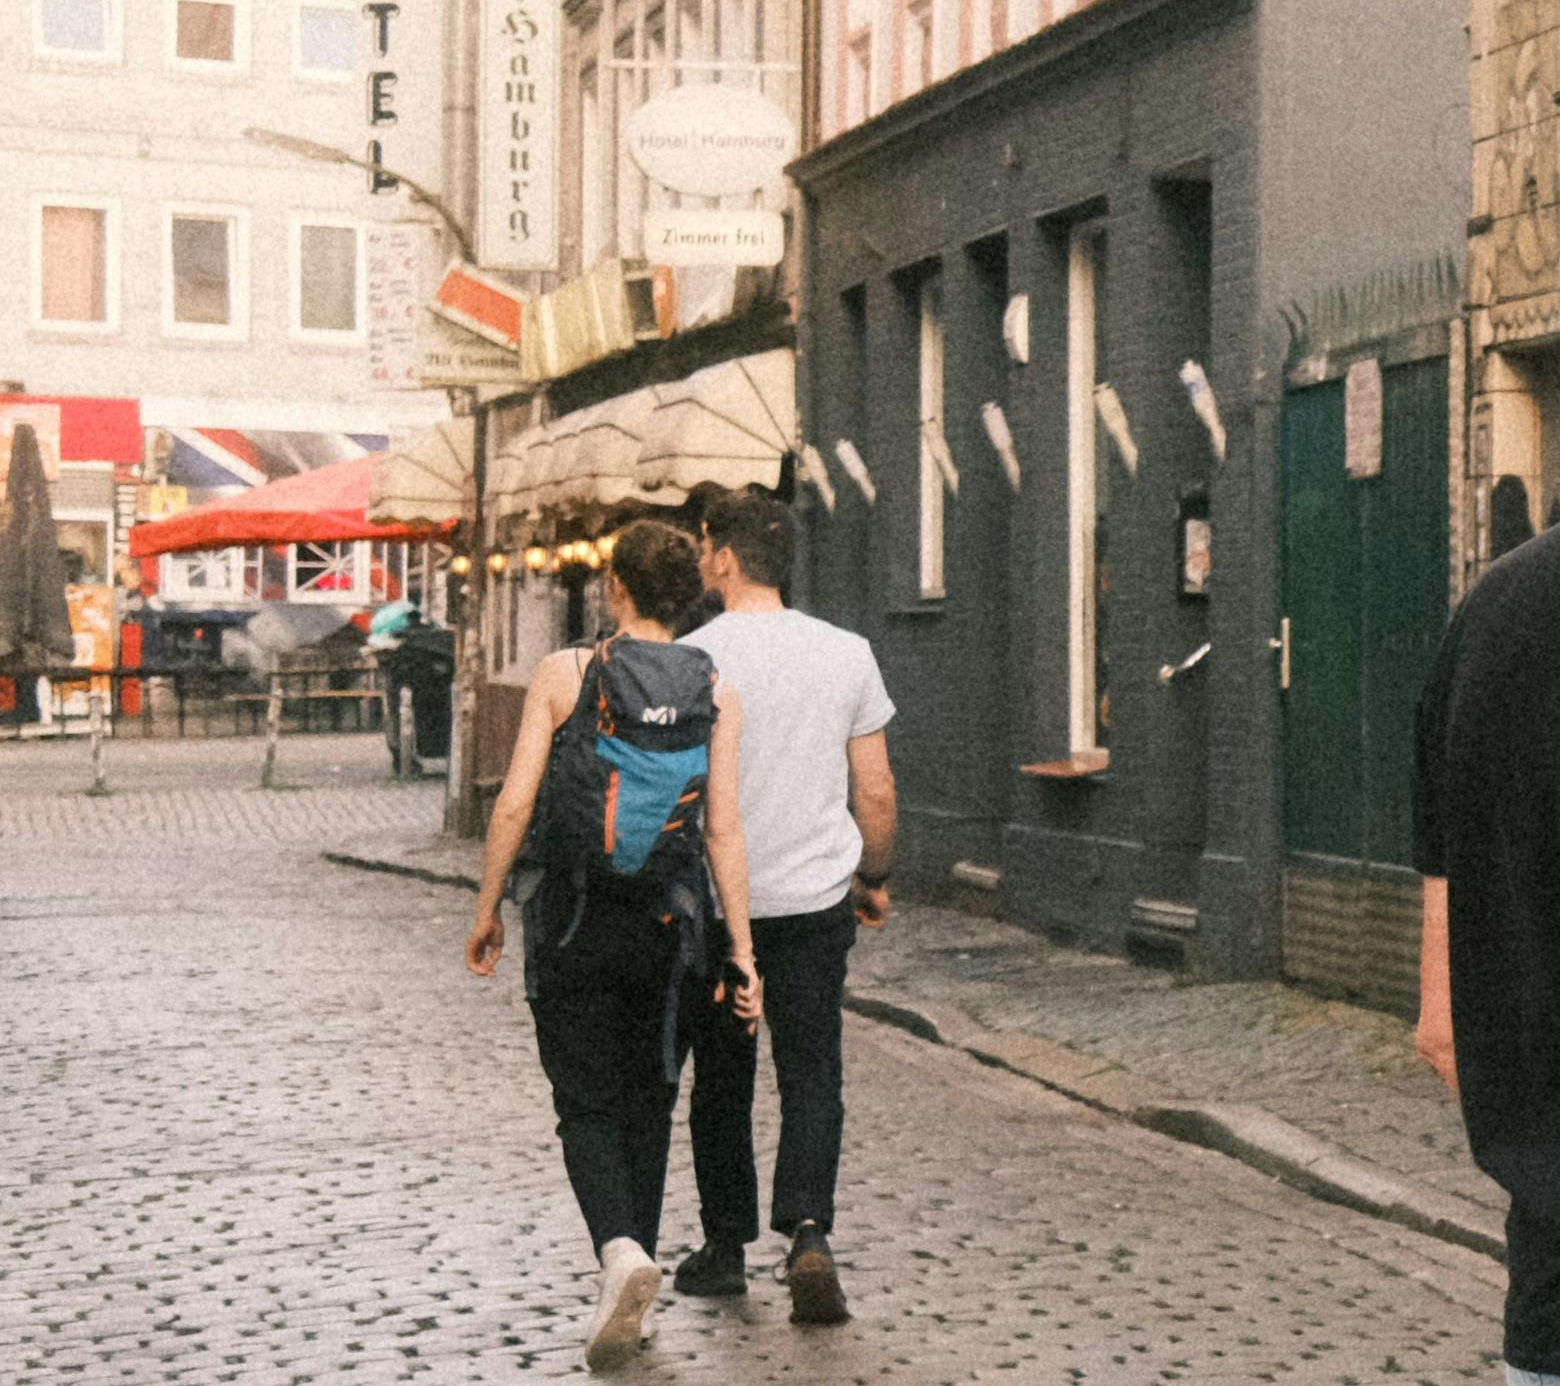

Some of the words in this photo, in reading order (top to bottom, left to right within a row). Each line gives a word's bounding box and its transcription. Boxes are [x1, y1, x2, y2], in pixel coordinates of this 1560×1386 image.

[640, 133, 688, 150] Hotel
[701, 134, 787, 150] Hamburg
[662, 229, 728, 246] Zimmer
[736, 228, 765, 246] frei
